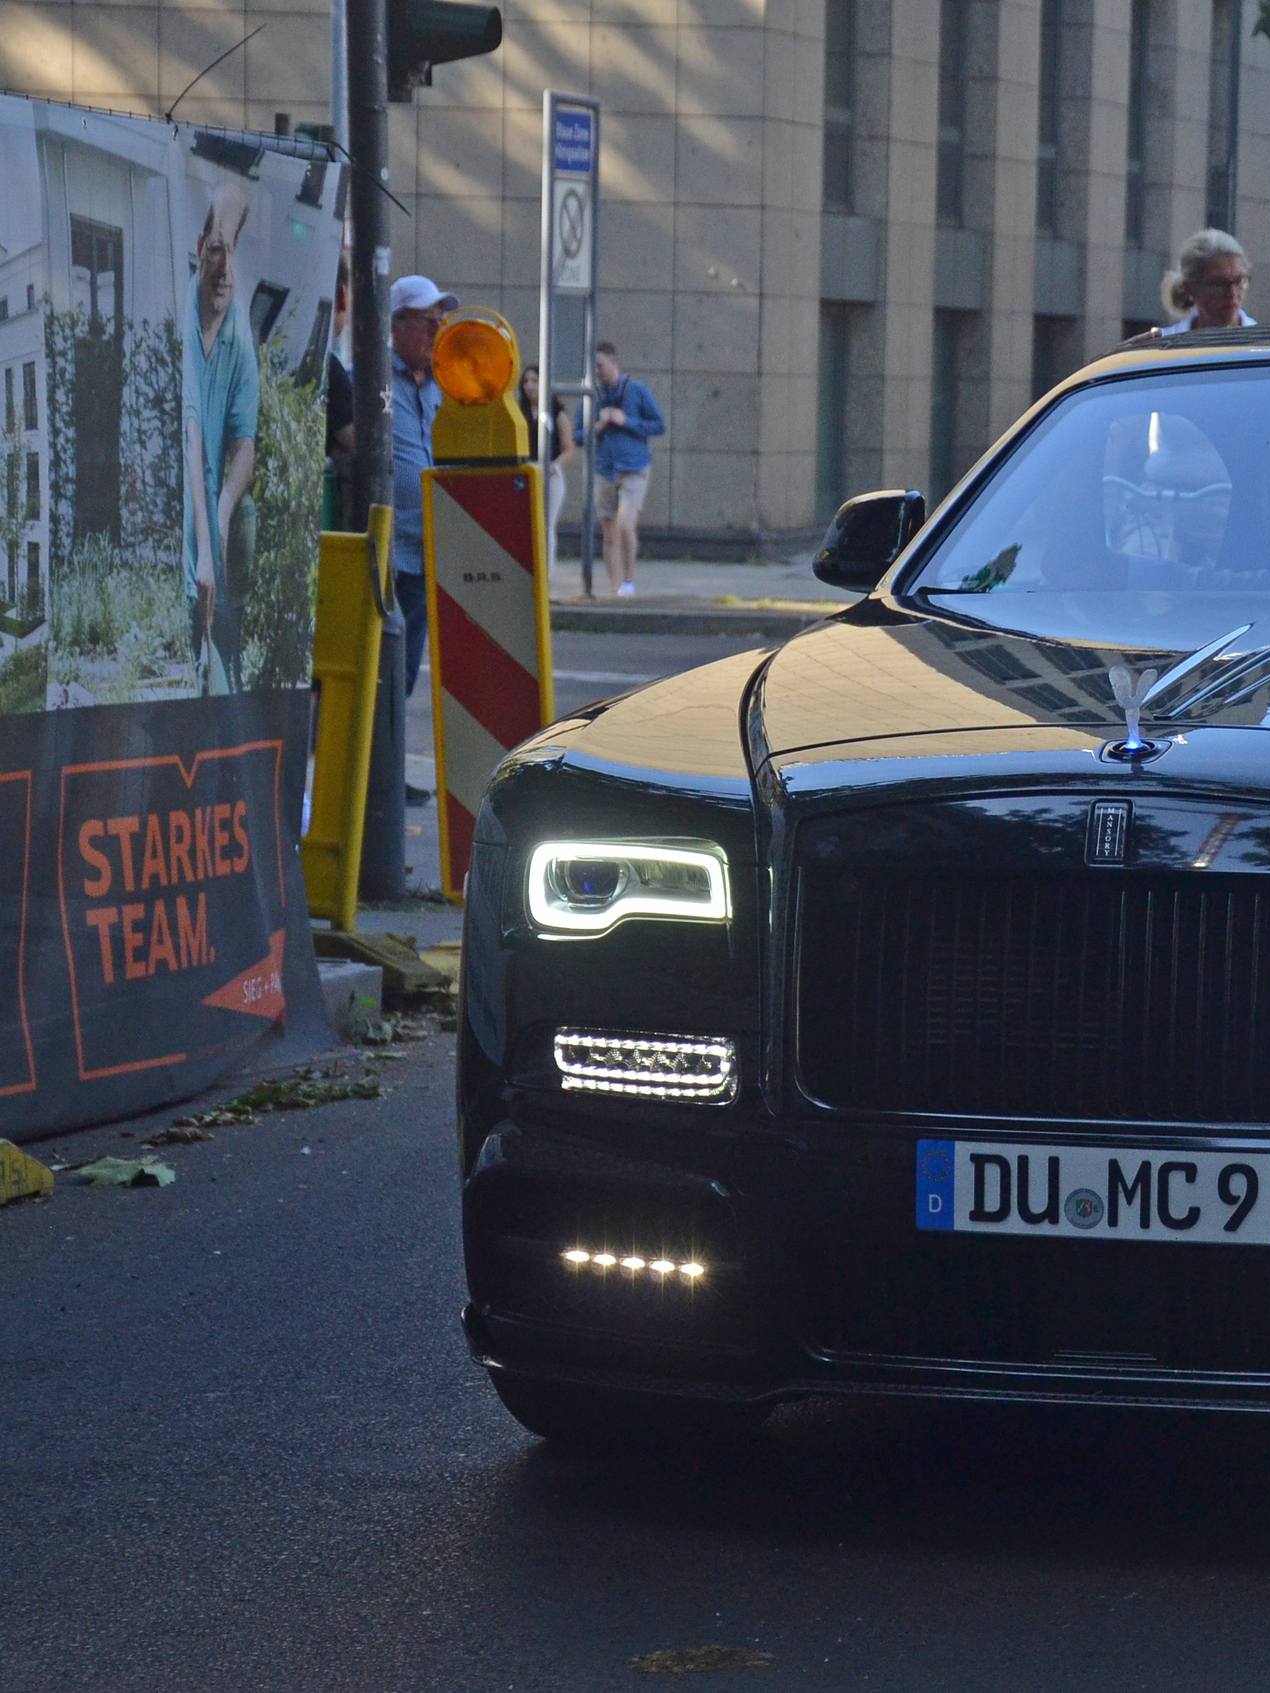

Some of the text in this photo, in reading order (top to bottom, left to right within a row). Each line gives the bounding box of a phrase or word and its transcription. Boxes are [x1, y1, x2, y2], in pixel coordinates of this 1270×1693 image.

[78, 800, 249, 897] STARKES
[1104, 807, 1116, 857] MANSORY
[86, 893, 216, 983] TEAM.
[928, 1194, 943, 1214] D
[969, 1153, 1060, 1225] DU
[1107, 1158, 1201, 1230] MC
[1217, 1163, 1259, 1232] 9
